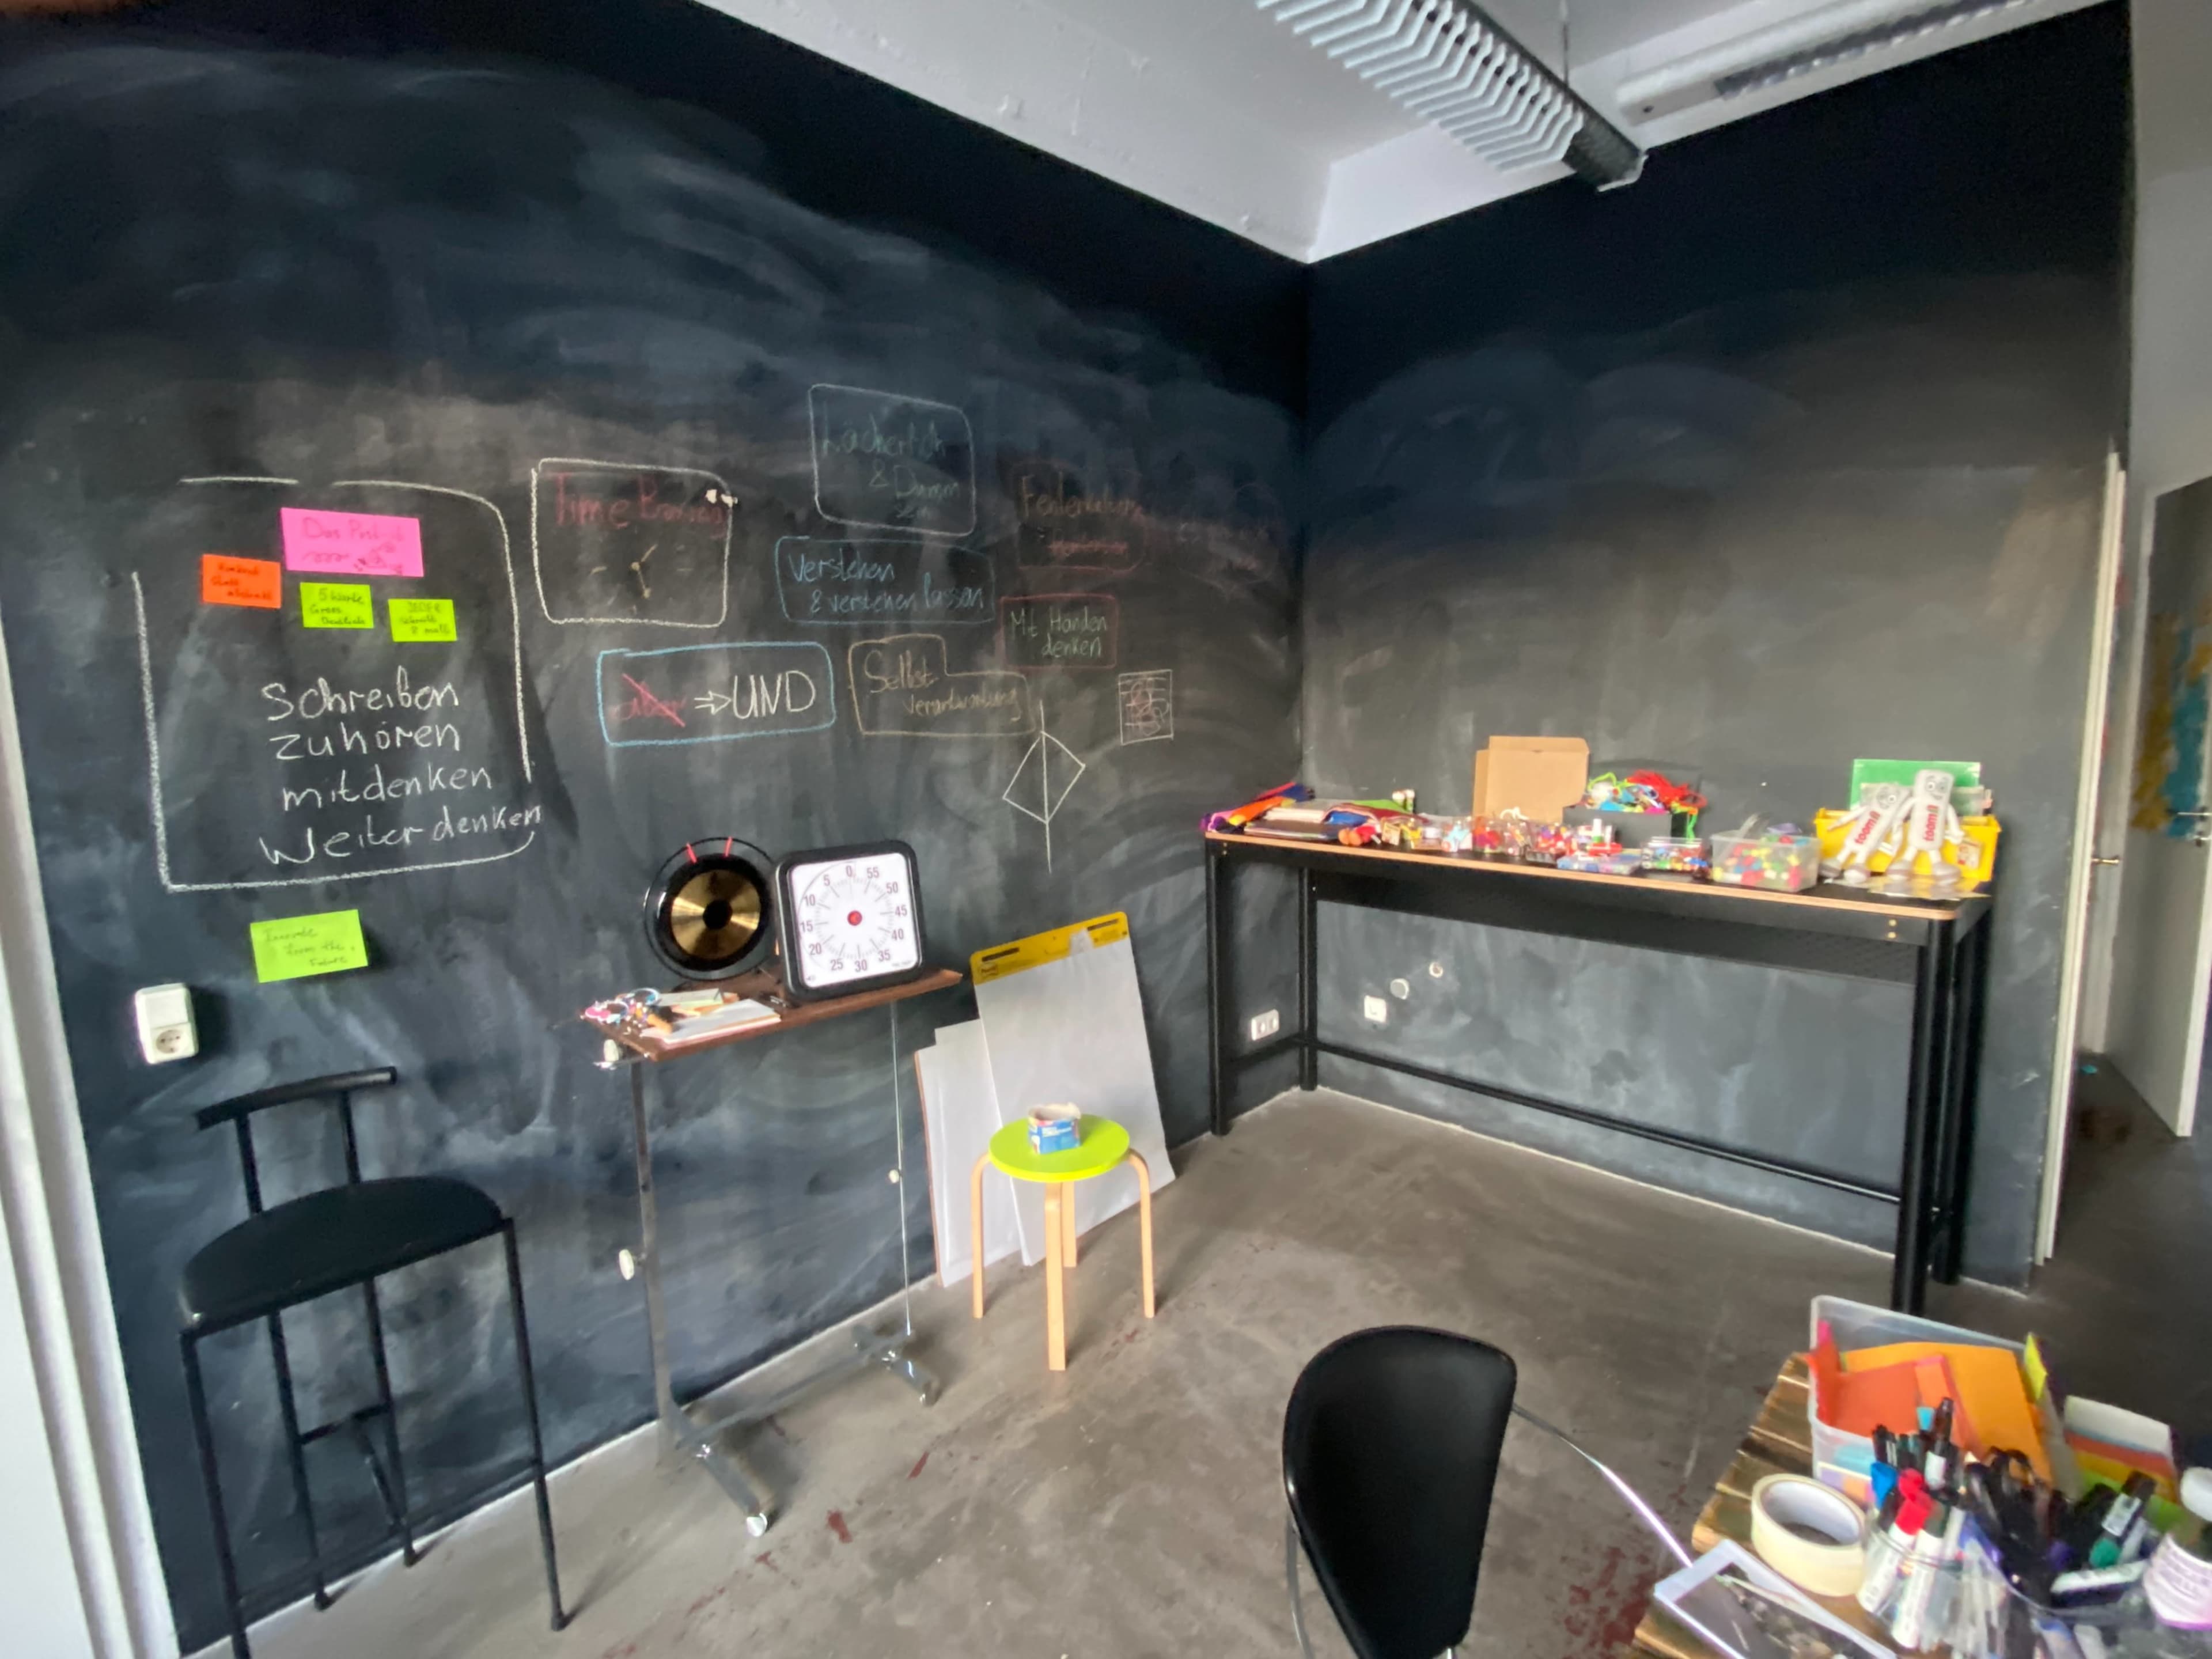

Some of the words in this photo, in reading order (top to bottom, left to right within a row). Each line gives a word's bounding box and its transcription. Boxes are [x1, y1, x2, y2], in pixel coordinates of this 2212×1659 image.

[788, 547, 895, 582] Verstehen
[1041, 632, 1103, 658] denken
[733, 670, 816, 719] UND
[283, 764, 492, 812] mitdenken
[845, 865, 853, 877] 0
[866, 867, 880, 879] 55
[823, 875, 831, 887] 5
[886, 881, 899, 893] 50
[804, 894, 816, 907] 10
[895, 905, 908, 916] 45
[800, 920, 813, 933] 15
[892, 928, 905, 941] 40
[808, 942, 823, 956] 20
[878, 950, 891, 962] 35
[830, 959, 844, 971] 25
[855, 959, 868, 972] 30
